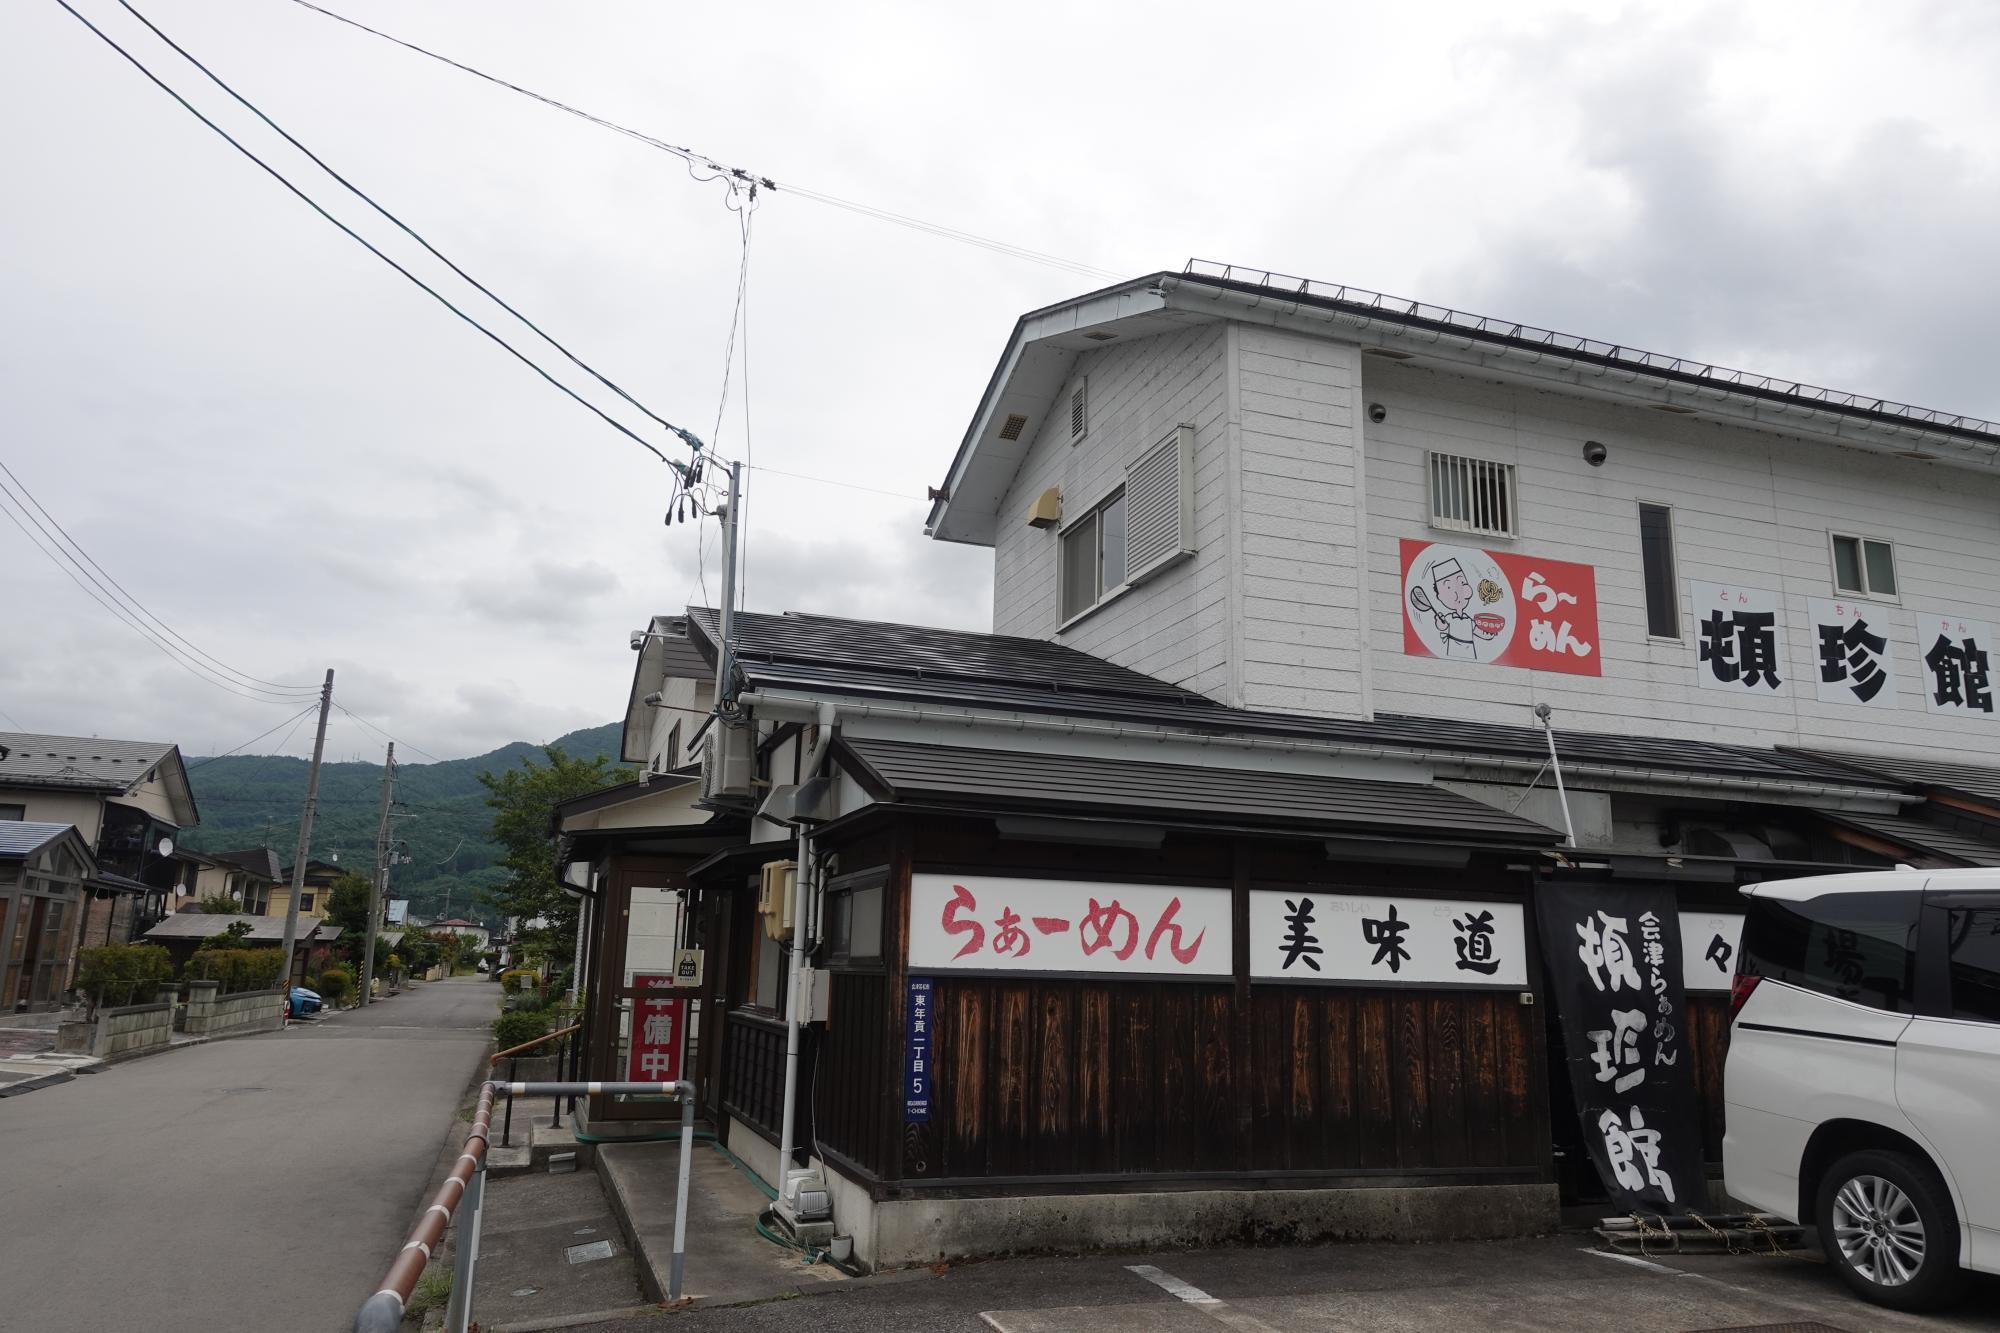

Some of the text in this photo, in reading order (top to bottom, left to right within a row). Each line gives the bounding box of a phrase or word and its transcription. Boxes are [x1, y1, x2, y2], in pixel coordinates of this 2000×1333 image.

[1719, 589, 1749, 604] とん
[1834, 604, 1863, 618] ちん
[1940, 620, 1967, 634] かん
[1529, 618, 1592, 657] めん
